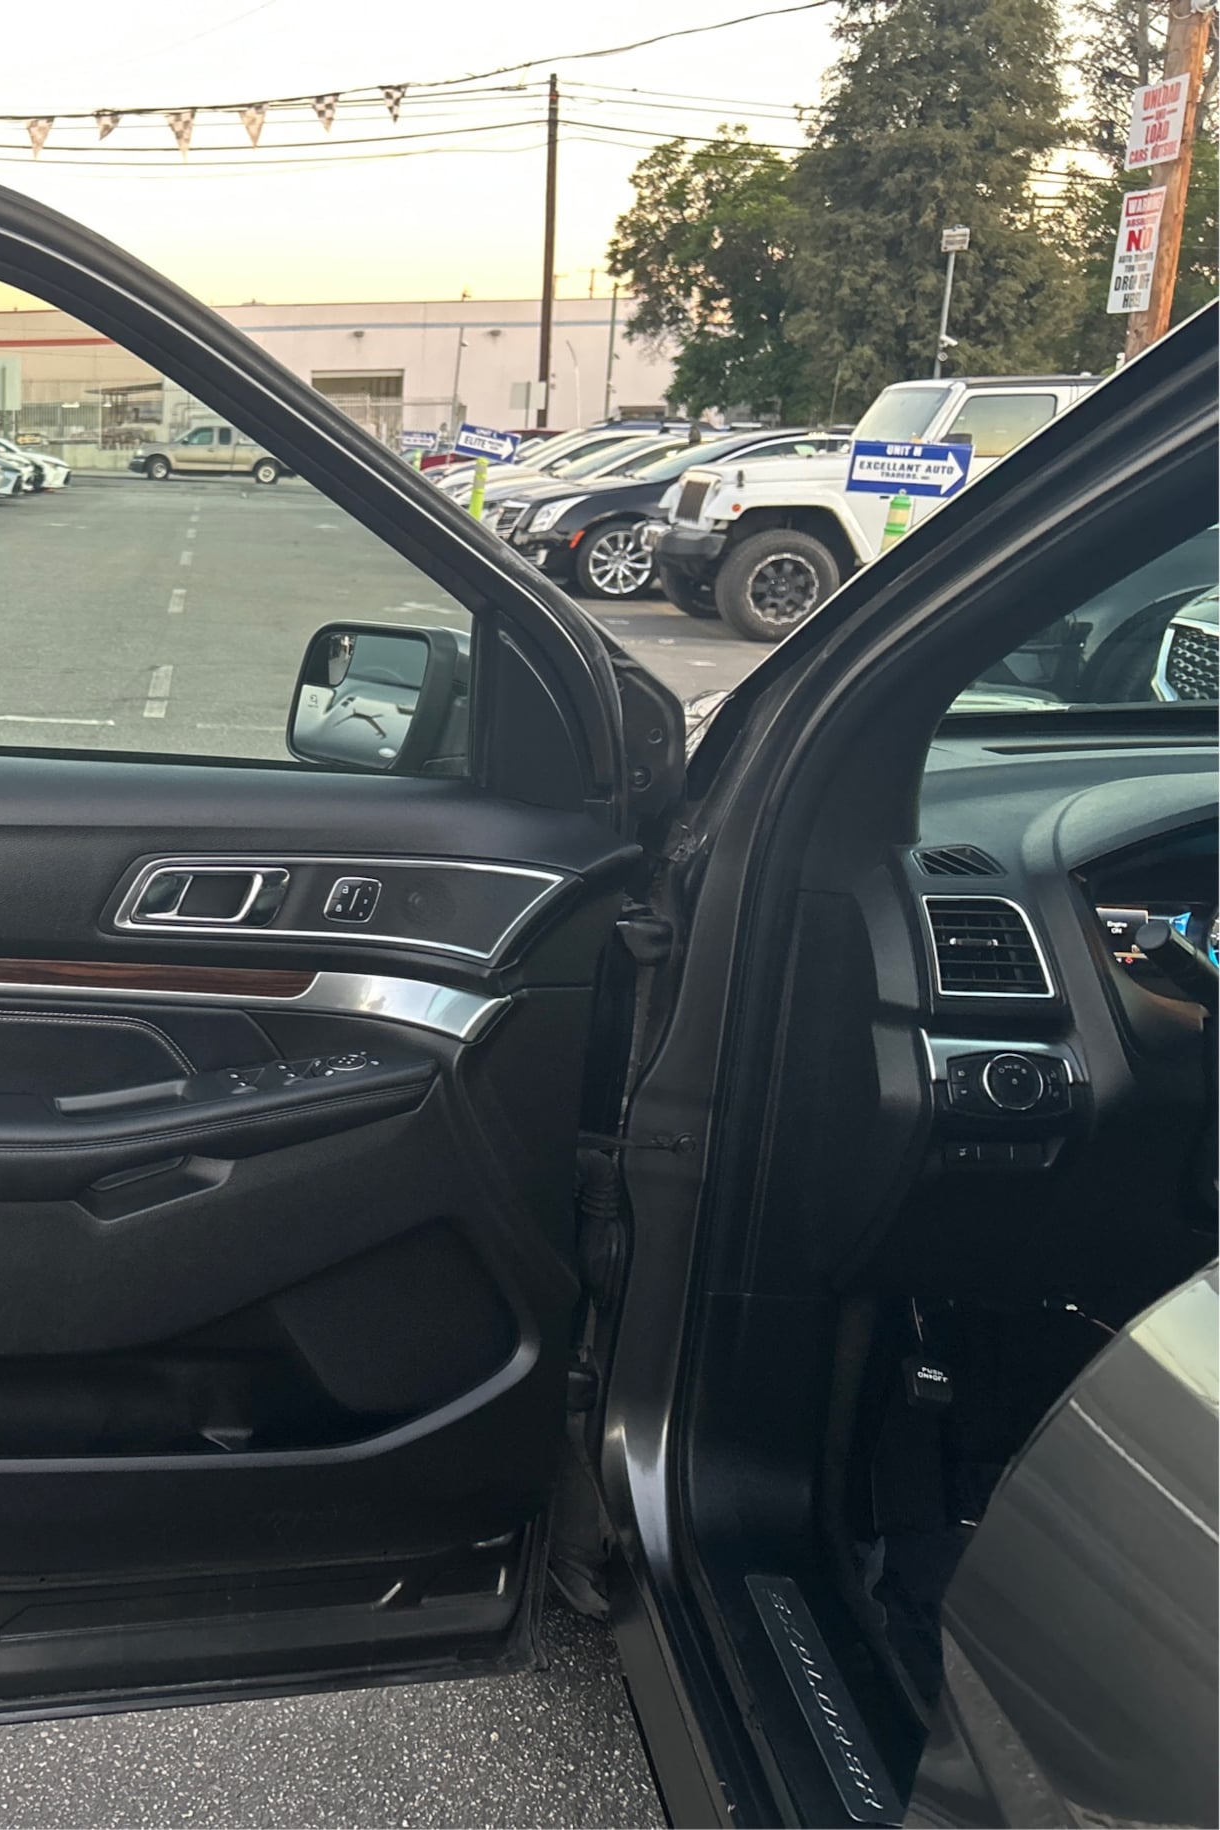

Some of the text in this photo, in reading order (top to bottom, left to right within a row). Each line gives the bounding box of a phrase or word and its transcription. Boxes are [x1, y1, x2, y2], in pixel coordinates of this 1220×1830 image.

[1143, 82, 1182, 111] UNLOAD
[1144, 120, 1170, 145] LOAD
[1129, 147, 1149, 165] CARS
[1126, 227, 1153, 252] NO
[464, 435, 487, 449] ELITE
[886, 444, 912, 456] UNIT
[859, 461, 954, 475] EXCELLANT AUTO
[767, 1588, 884, 1810] EXPLORER
